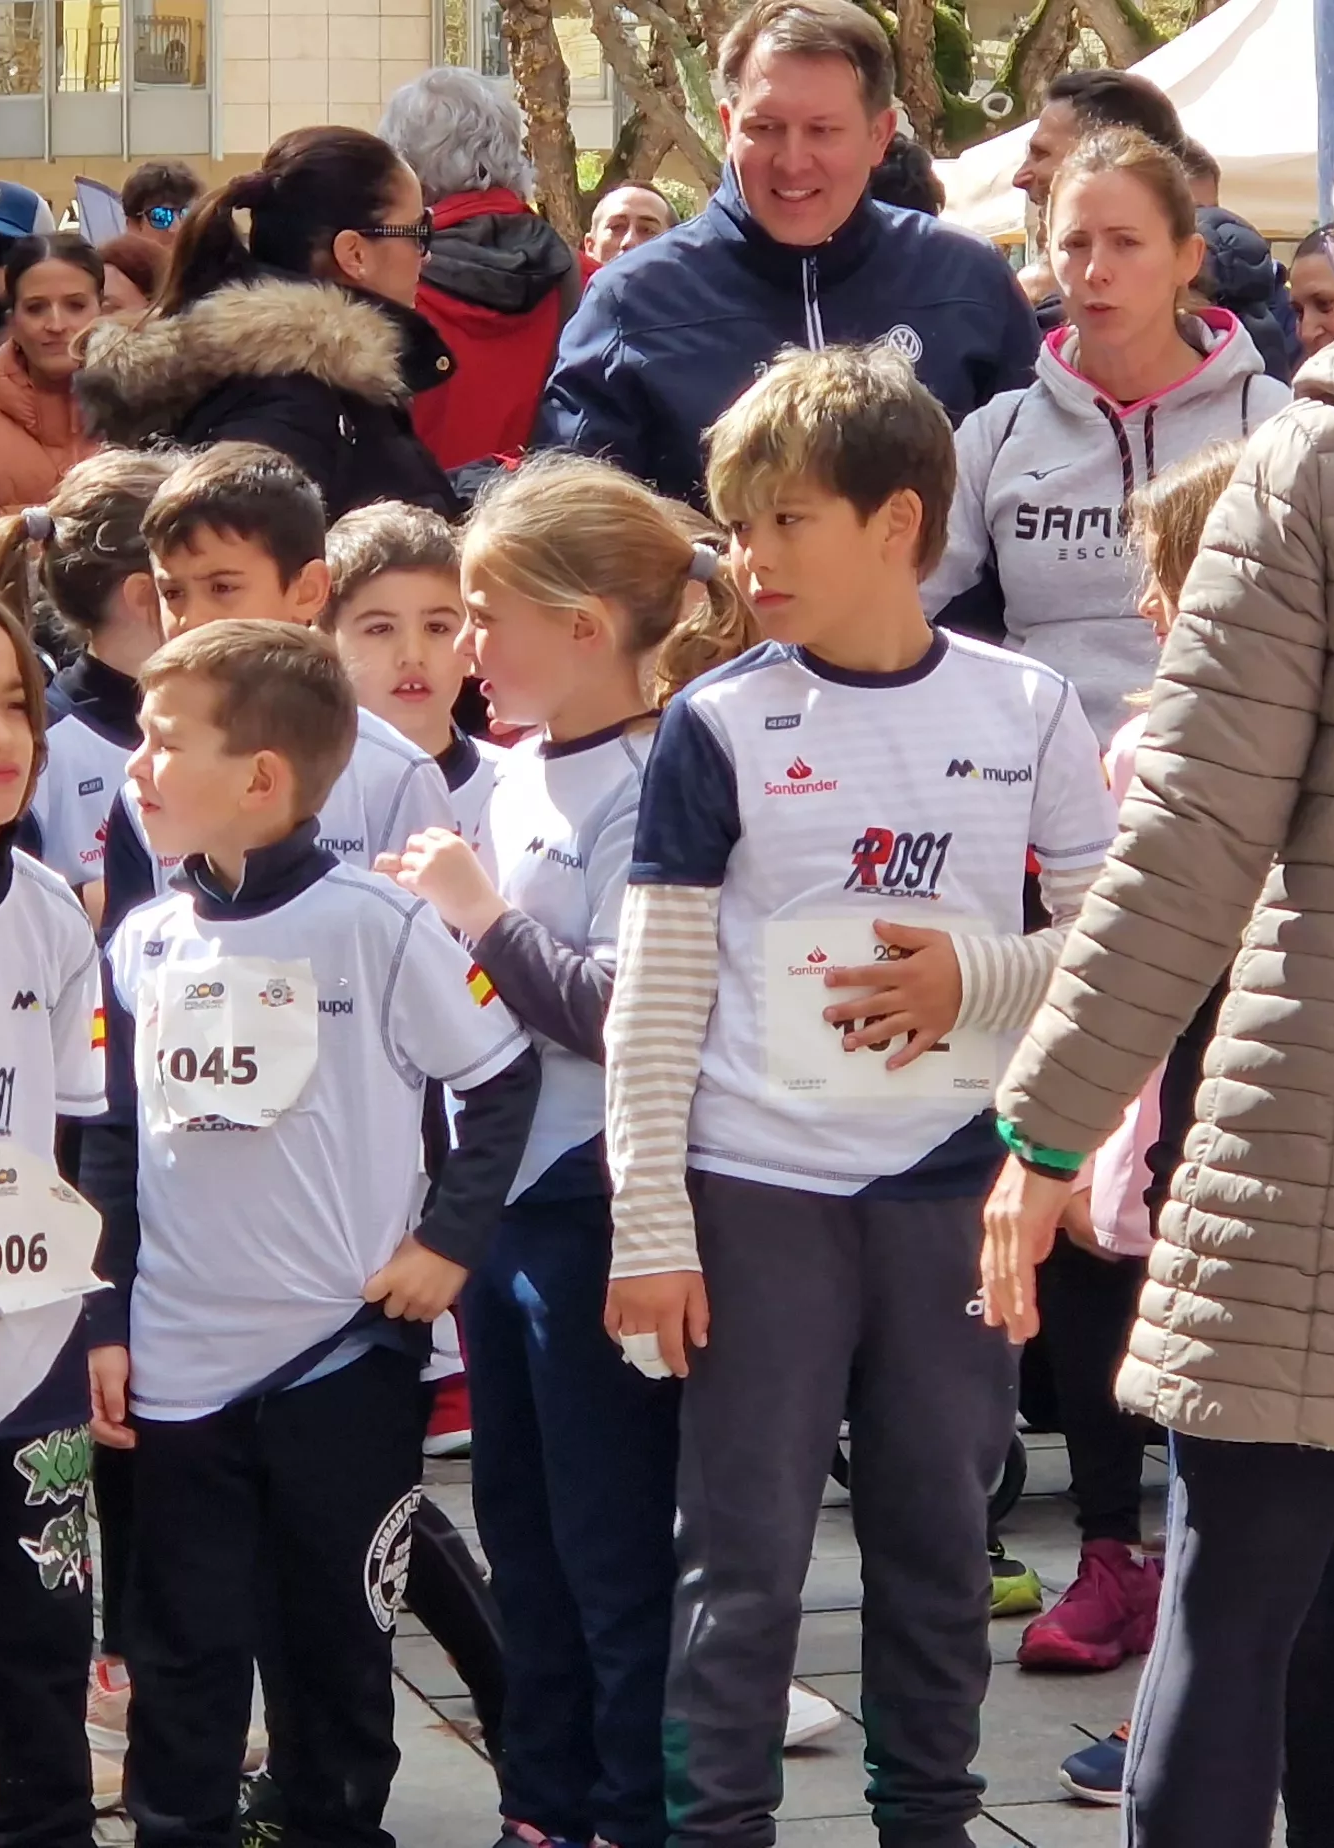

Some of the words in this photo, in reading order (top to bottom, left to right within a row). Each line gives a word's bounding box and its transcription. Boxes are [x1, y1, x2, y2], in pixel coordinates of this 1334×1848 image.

[983, 765, 1033, 786] mupol
[764, 780, 838, 796] Santander
[319, 837, 364, 855] mupol
[547, 847, 583, 869] mupol
